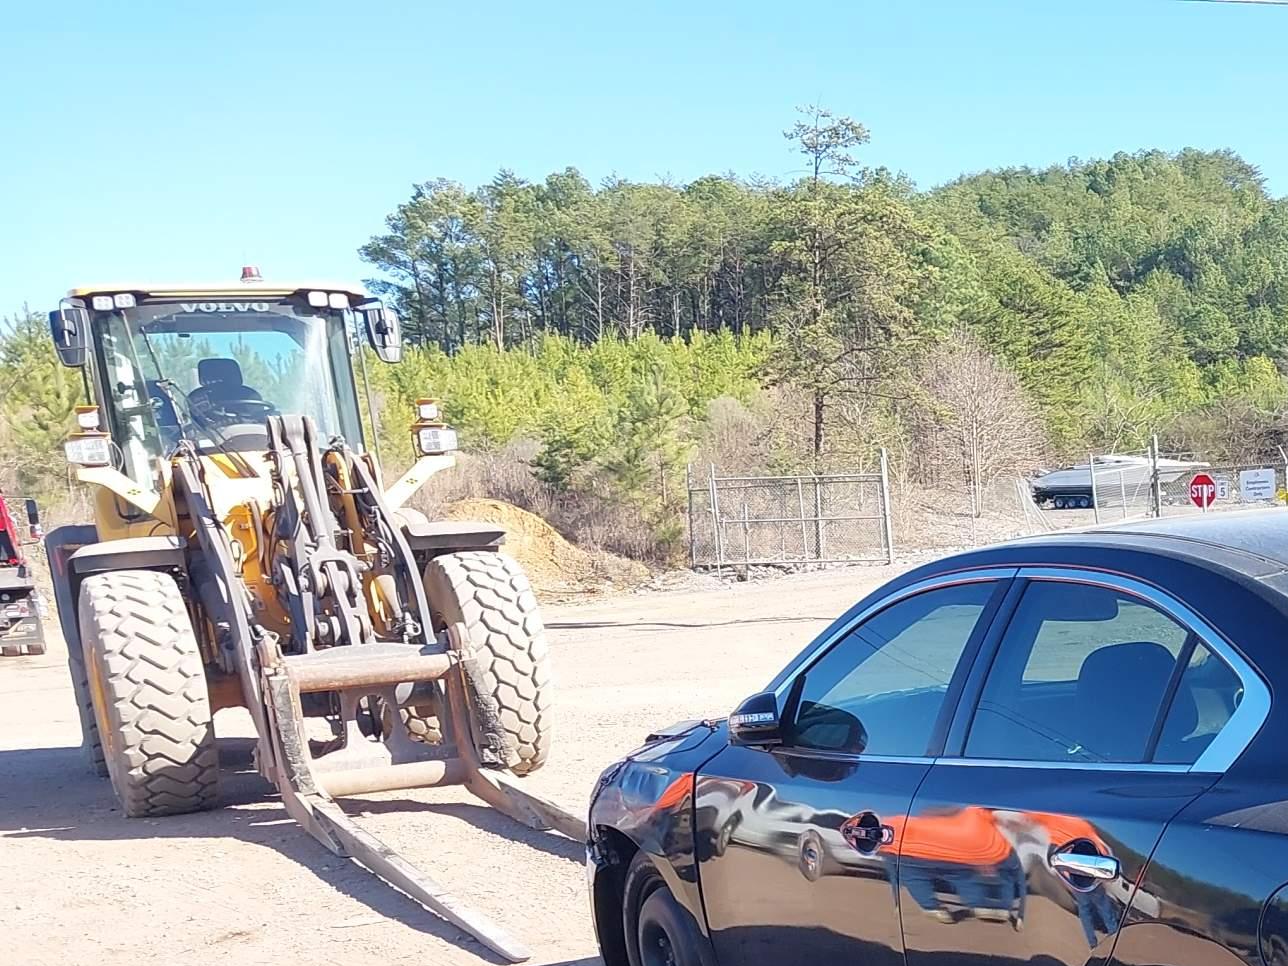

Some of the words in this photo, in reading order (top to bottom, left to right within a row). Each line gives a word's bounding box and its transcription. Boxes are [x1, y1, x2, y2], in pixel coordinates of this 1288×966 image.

[180, 302, 270, 313] VOLVO
[1191, 485, 1215, 498] STP
[1220, 487, 1226, 497] 5
